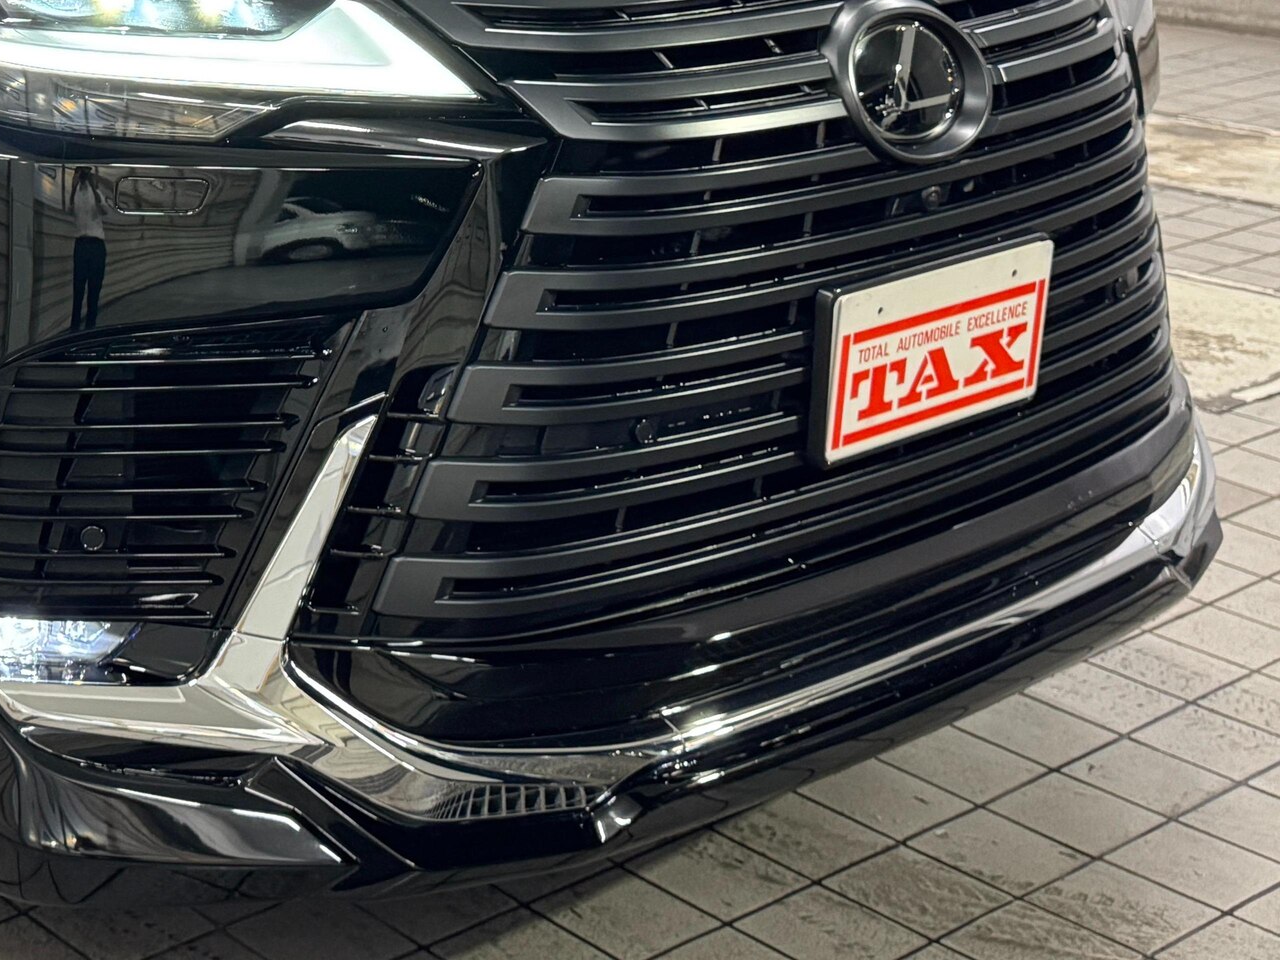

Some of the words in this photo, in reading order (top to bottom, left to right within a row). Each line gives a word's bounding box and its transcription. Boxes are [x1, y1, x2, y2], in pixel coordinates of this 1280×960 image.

[850, 321, 1028, 422] TAX
[858, 342, 890, 365] TOTAL
[896, 320, 961, 351] AUTOMOBILE
[967, 301, 1028, 332] EXCELLENCE
